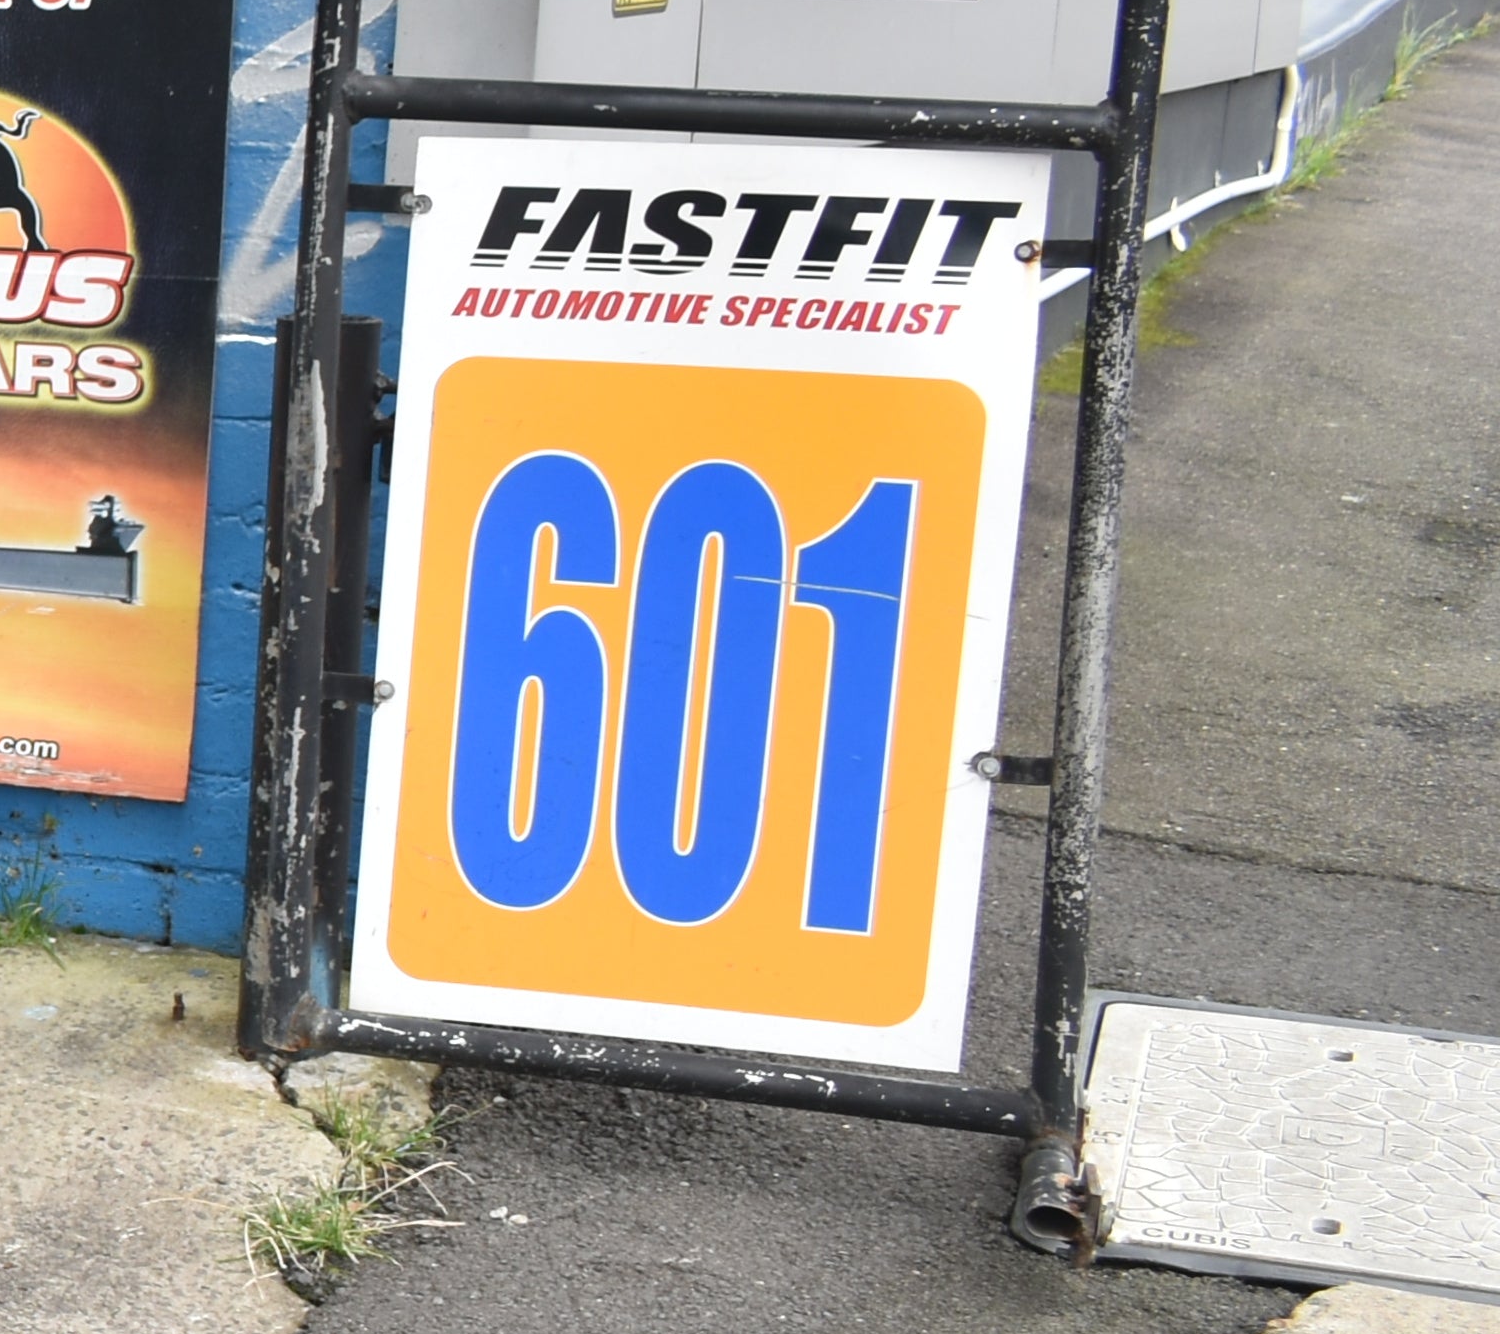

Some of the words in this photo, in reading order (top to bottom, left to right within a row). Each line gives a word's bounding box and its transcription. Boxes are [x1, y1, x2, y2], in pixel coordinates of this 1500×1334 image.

[470, 186, 1022, 285] FASTFIT
[451, 286, 716, 325] AUTOMOTIVE
[720, 295, 962, 336] SPECIALIST
[447, 449, 922, 936] 601
[1141, 1227, 1251, 1249] CUBIS
